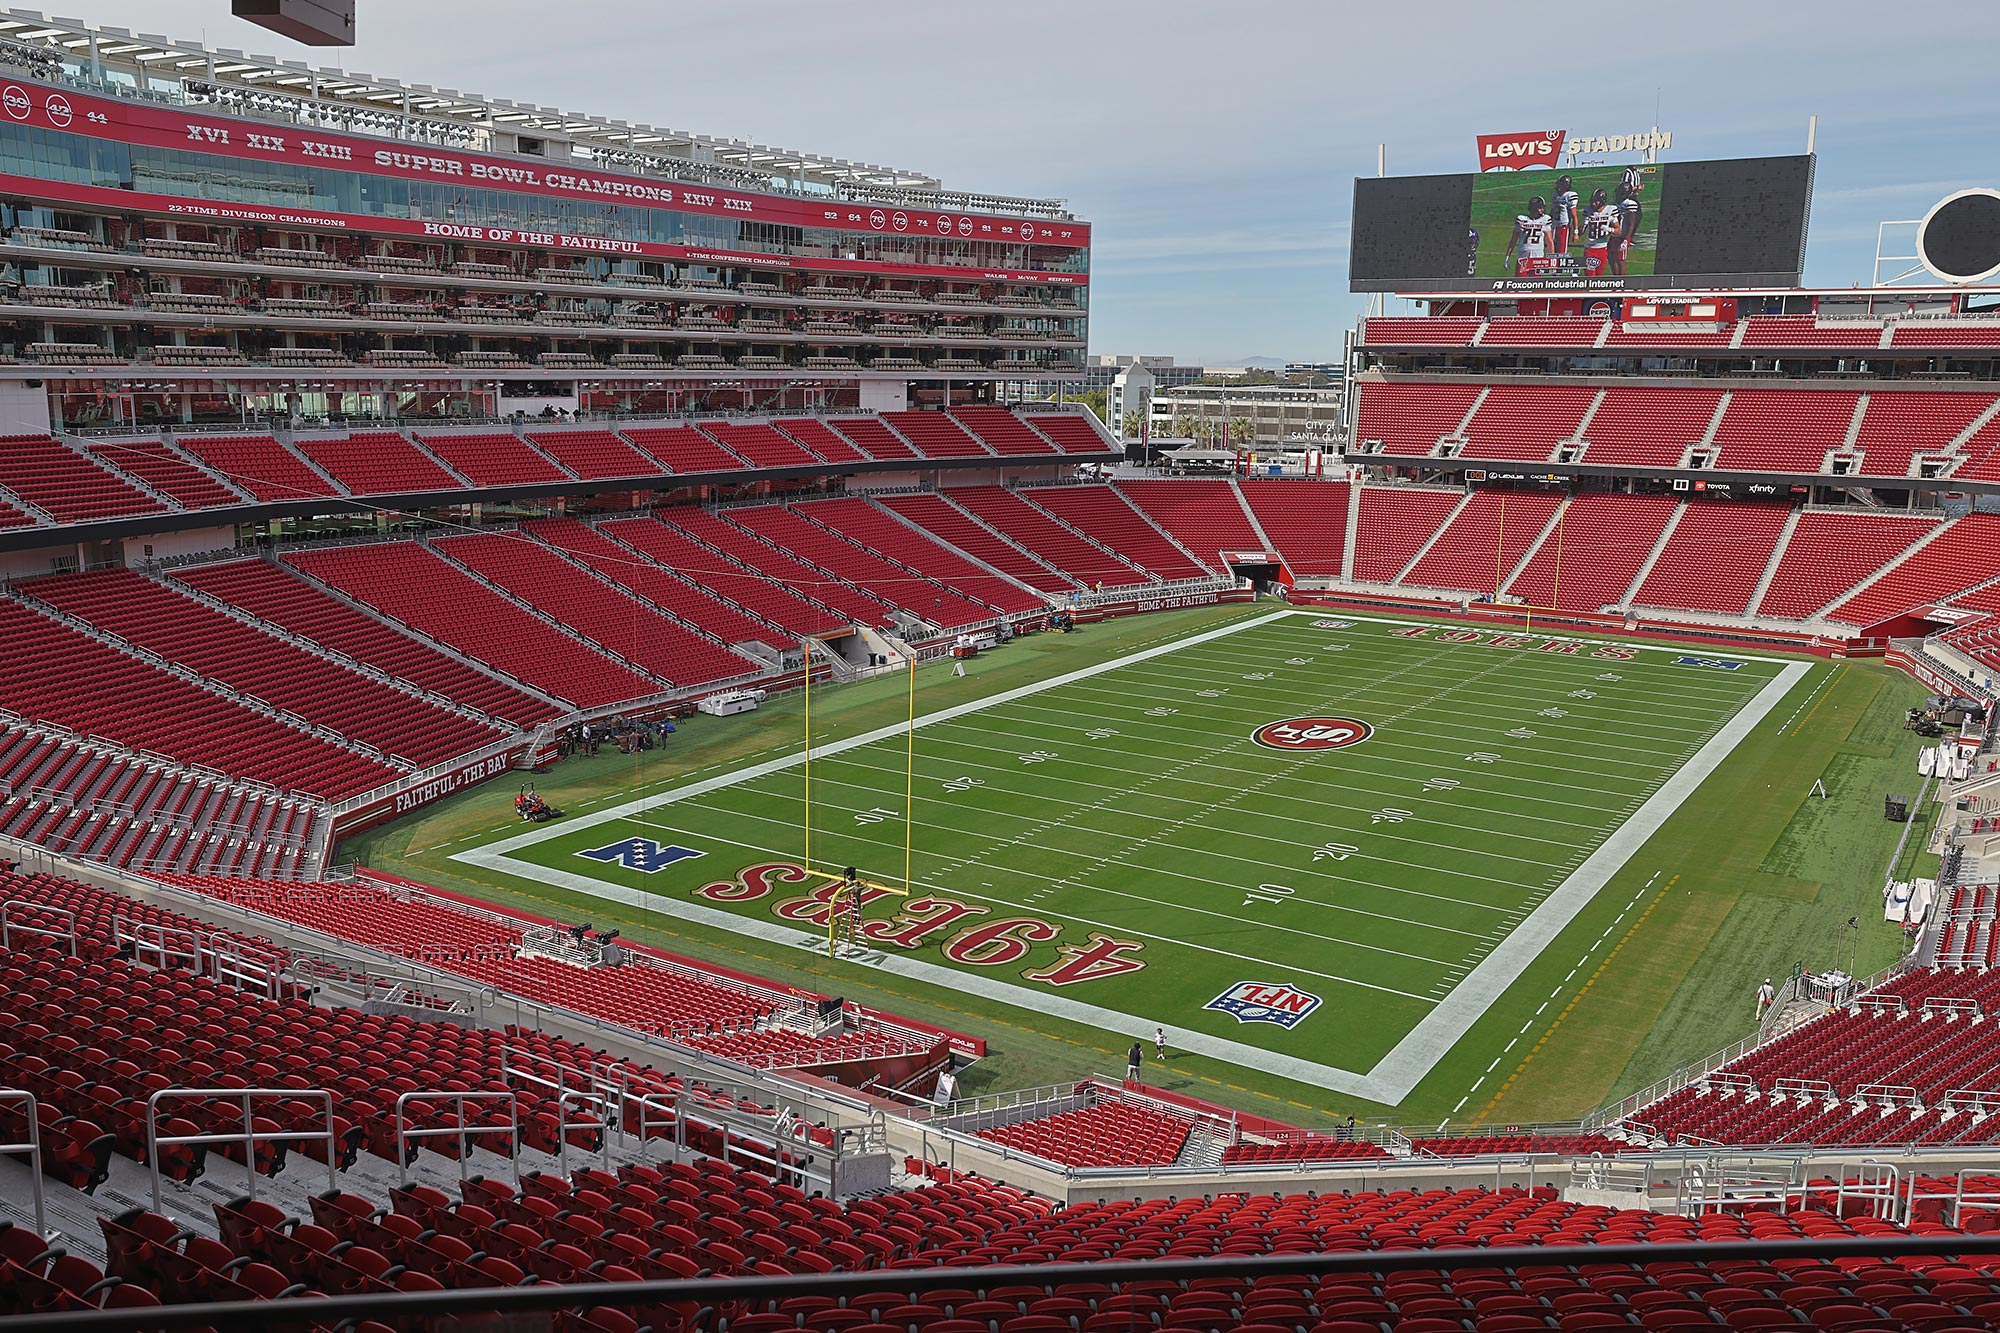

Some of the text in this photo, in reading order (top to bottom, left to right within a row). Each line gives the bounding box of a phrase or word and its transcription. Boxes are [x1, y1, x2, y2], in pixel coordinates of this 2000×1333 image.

[5, 95, 28, 109] 39
[48, 104, 70, 117] 42
[87, 111, 108, 125] 44
[1566, 131, 1672, 155] STADIUM
[186, 124, 753, 212] XVI XIX XXIII SUPER BOWL CHAMPIONS XXIV XXIX
[168, 204, 346, 227] 22-TIME DIVISION CHAMPIONS
[424, 222, 642, 253] HOME OF THE FAITHFUL
[1523, 228, 1542, 244] 75
[711, 254, 752, 263] CONFERENCE
[753, 258, 790, 266] CHAMPIONS
[1506, 280, 1544, 289] Foxconn
[1545, 279, 1587, 289] Industrial
[1589, 279, 1624, 288] Internet
[1305, 420, 1323, 430] CITY
[1291, 431, 1349, 442] SANTA CLARA
[1748, 483, 1777, 494] xfinity
[1137, 600, 1160, 612] HOME
[1165, 597, 1181, 608] THE
[1182, 594, 1219, 607] FAITHFUL
[1388, 626, 1641, 661] 49ERS
[1018, 750, 1059, 763] 30
[396, 775, 455, 813] FAITHFUL
[462, 762, 485, 785] THE
[487, 753, 508, 775] BAY
[942, 776, 985, 791] 20
[1423, 777, 1461, 790] 40
[854, 806, 899, 824] 10
[1371, 807, 1414, 823] 30
[1313, 842, 1359, 861] 20
[1246, 883, 1295, 905] 10
[690, 861, 1148, 988] 49ERS
[1241, 985, 1313, 1013] NFL
[857, 1072, 881, 1091] LEXUS
[1152, 1102, 1164, 1110] 125
